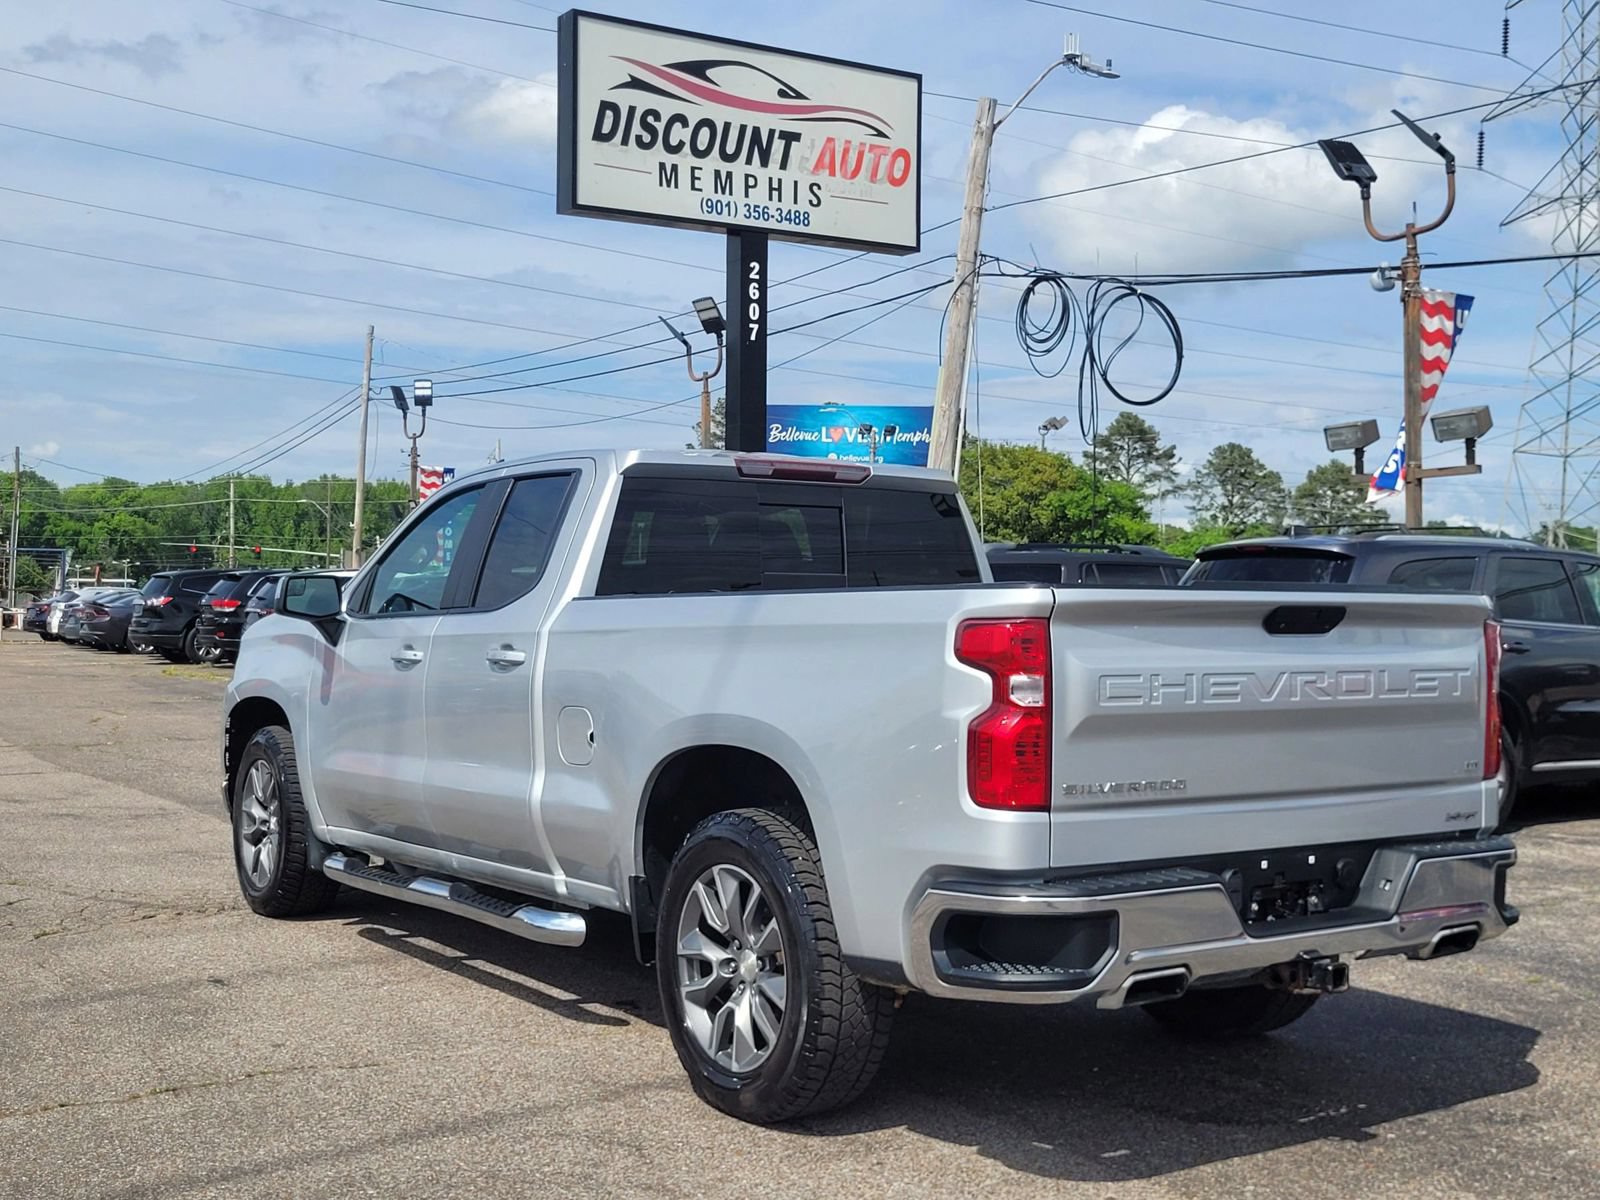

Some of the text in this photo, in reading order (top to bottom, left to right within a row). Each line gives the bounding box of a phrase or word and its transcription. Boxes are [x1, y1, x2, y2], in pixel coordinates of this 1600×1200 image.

[592, 99, 912, 188] DISCOUNT AUTO
[658, 161, 822, 208] MEMPHIS
[700, 197, 811, 227] (901) 356-3488
[748, 261, 760, 341] 2607
[768, 423, 821, 443] Bellevue
[1097, 666, 1472, 707] CHEVROLET
[1062, 779, 1187, 796] SILVERADO
